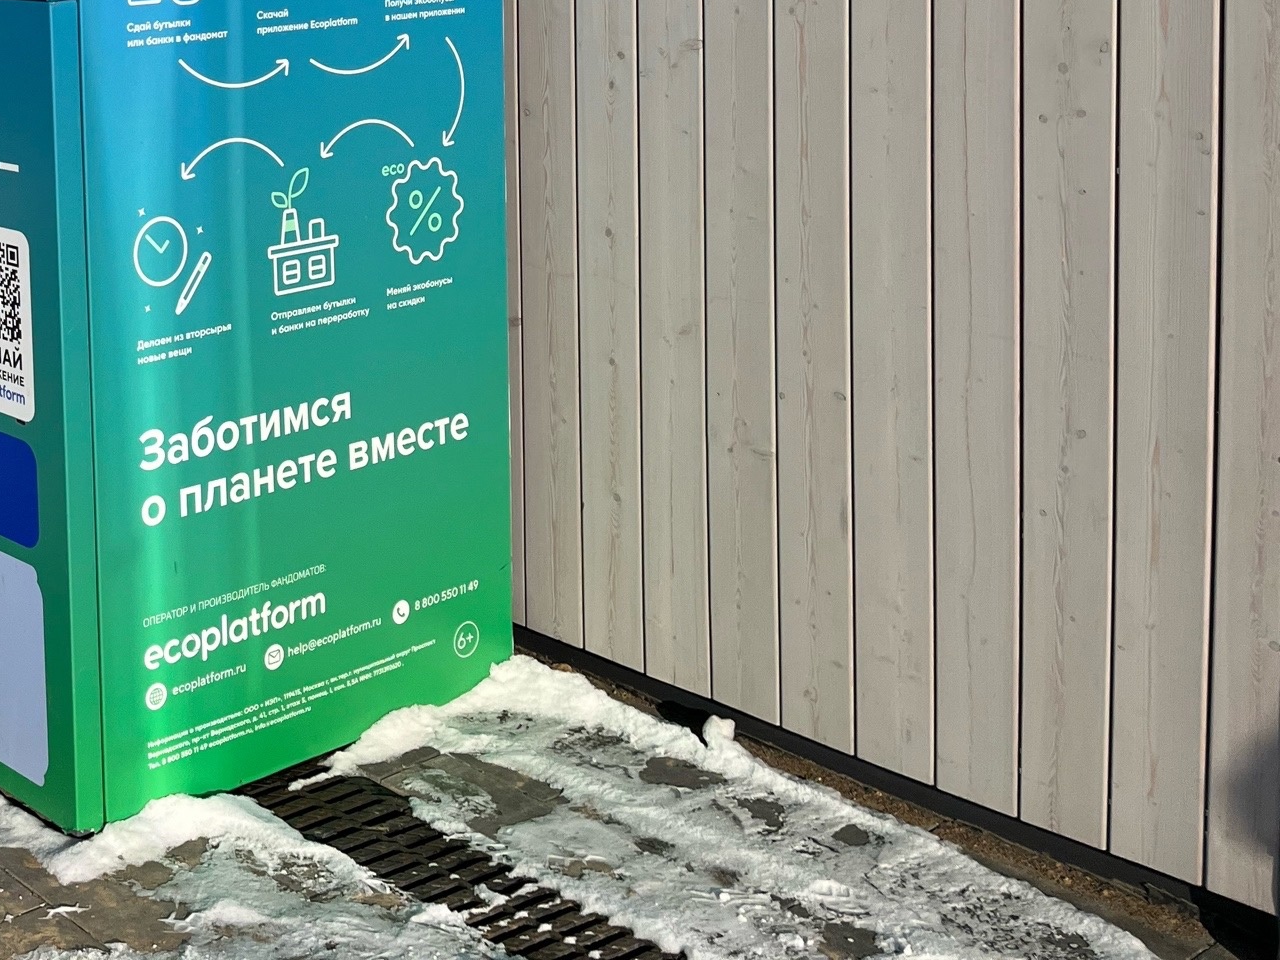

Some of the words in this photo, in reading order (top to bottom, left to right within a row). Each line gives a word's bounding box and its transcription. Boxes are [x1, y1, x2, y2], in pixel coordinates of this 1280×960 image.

[256, 8, 289, 20] Скачай
[391, 12, 418, 21] нашем
[419, 7, 466, 20] приложении
[126, 22, 151, 33] Сдай
[153, 19, 191, 31] бутылки
[257, 22, 309, 36] приложение
[310, 17, 358, 30] Ecoplatform
[127, 39, 144, 48] или
[146, 36, 174, 46] банки
[183, 30, 229, 44] фандомат
[381, 163, 405, 177] eco
[386, 284, 411, 296] Меняй
[413, 277, 453, 291] экобонусы
[270, 304, 322, 321] Отправляем
[323, 297, 357, 311] бутылки
[398, 296, 425, 306] скидки
[271, 327, 277, 335] и
[278, 322, 304, 334] банки
[305, 319, 316, 329] на
[317, 308, 370, 326] переработку
[137, 336, 172, 351] Делаем
[174, 334, 184, 343] из
[186, 323, 232, 338] вторсырья
[137, 353, 166, 365] новые
[168, 347, 192, 358] вещи
[139, 391, 353, 472] Заботимся
[140, 494, 167, 527] о
[179, 448, 338, 519] планете
[348, 411, 470, 472] вместе
[142, 606, 189, 628] ОПЕРАТОР
[190, 604, 197, 614] И
[198, 582, 270, 611] ПРОИЗВОДИТЕЛЬ
[270, 563, 327, 588] ФАНДОМАТОВ:
[414, 600, 421, 611] 8
[421, 593, 440, 609] 800
[441, 587, 459, 603] 550
[459, 583, 467, 594] 11
[467, 579, 479, 591] 49
[143, 592, 326, 671] ecoplatform
[287, 617, 382, 658] help@ecoplatform.ru
[457, 631, 474, 650] 6+
[171, 663, 247, 696] ecoplatform.ru
[244, 704, 259, 714] ООО
